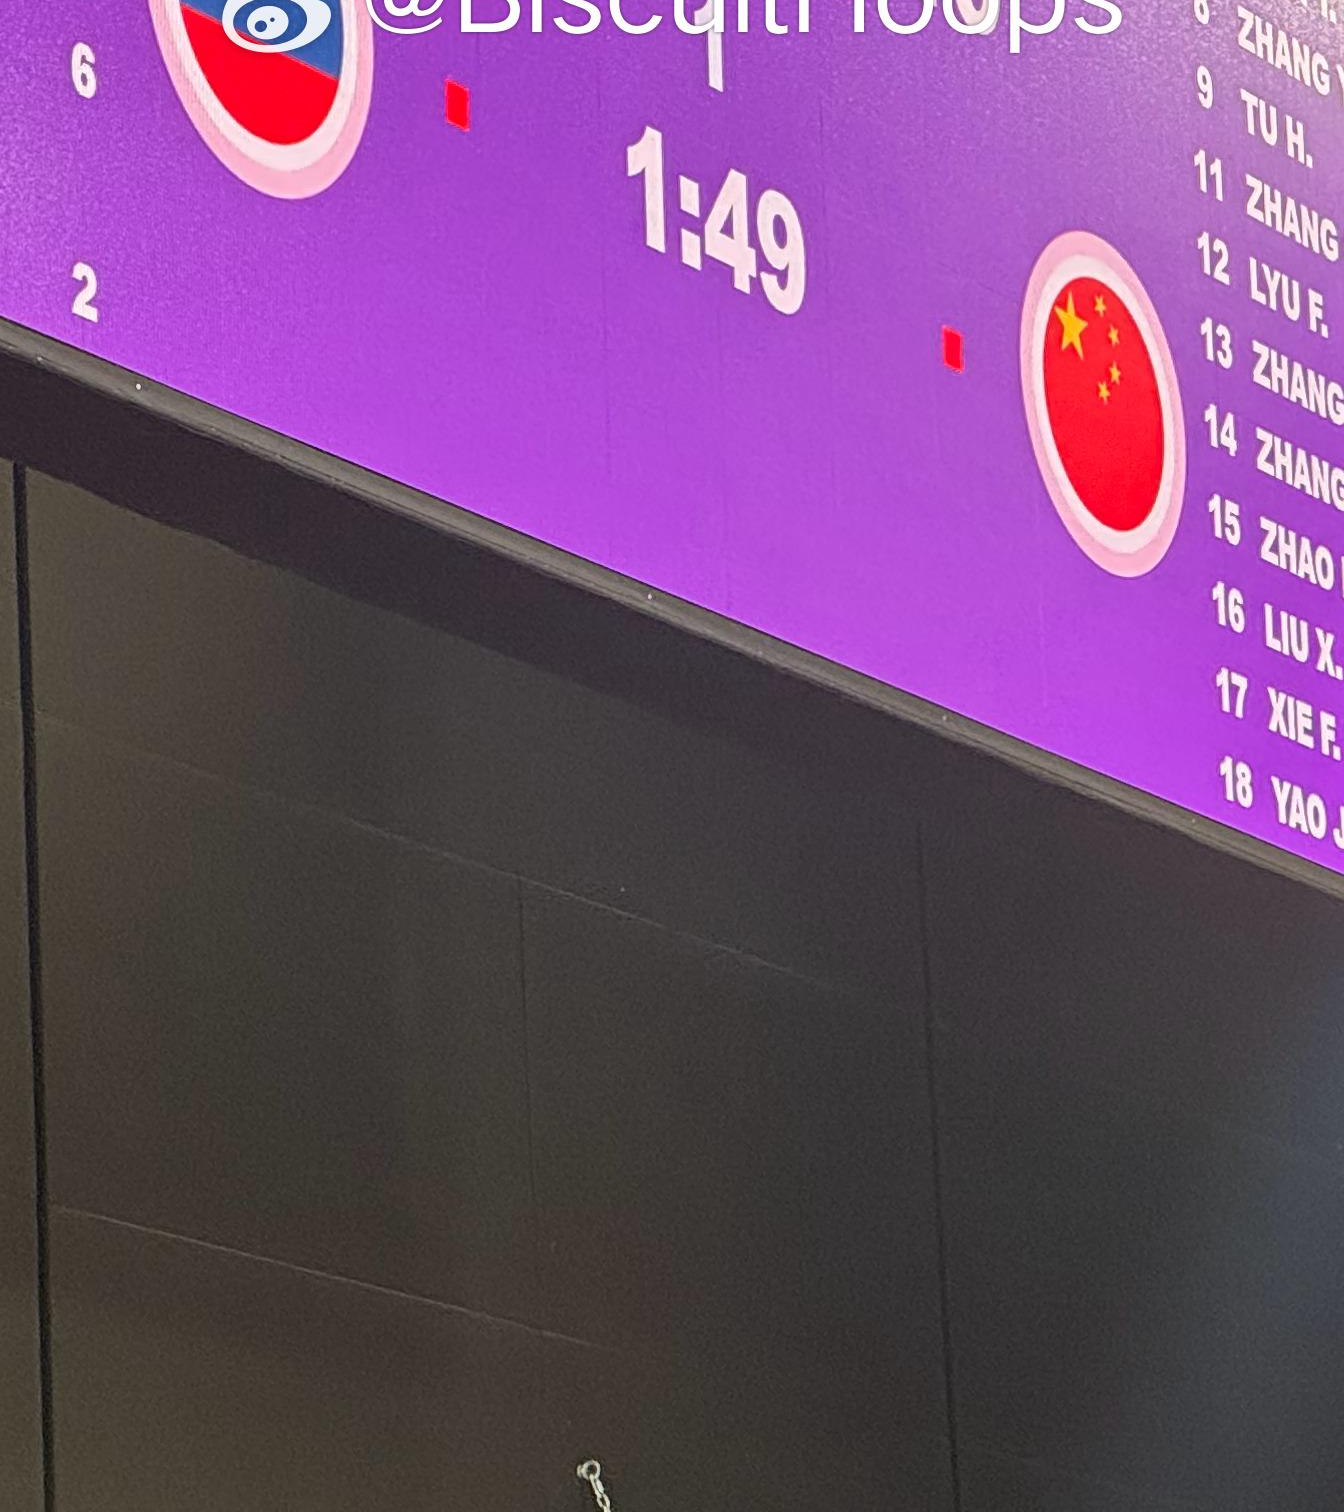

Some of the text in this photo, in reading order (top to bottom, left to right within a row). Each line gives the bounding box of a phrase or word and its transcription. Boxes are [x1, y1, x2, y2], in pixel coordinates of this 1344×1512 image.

[72, 42, 97, 98] 6
[1236, 5, 1331, 97] ZHANG
[1197, 65, 1313, 168] 9 TU H.
[626, 125, 805, 315] 1:49
[1194, 149, 1223, 202] 11
[1246, 174, 1339, 263] ZHANG
[71, 262, 98, 323] 2
[1197, 231, 1329, 338] 12 LYU F.
[1200, 317, 1233, 369] 13
[1203, 403, 1237, 456] 14
[1208, 494, 1240, 547] 15
[1260, 515, 1334, 591] ZHAO
[1212, 581, 1343, 681] 16 LIU X.
[1215, 667, 1342, 761] 17 XIE F.
[1219, 754, 1254, 809] 18
[1271, 775, 1327, 840] YAO
